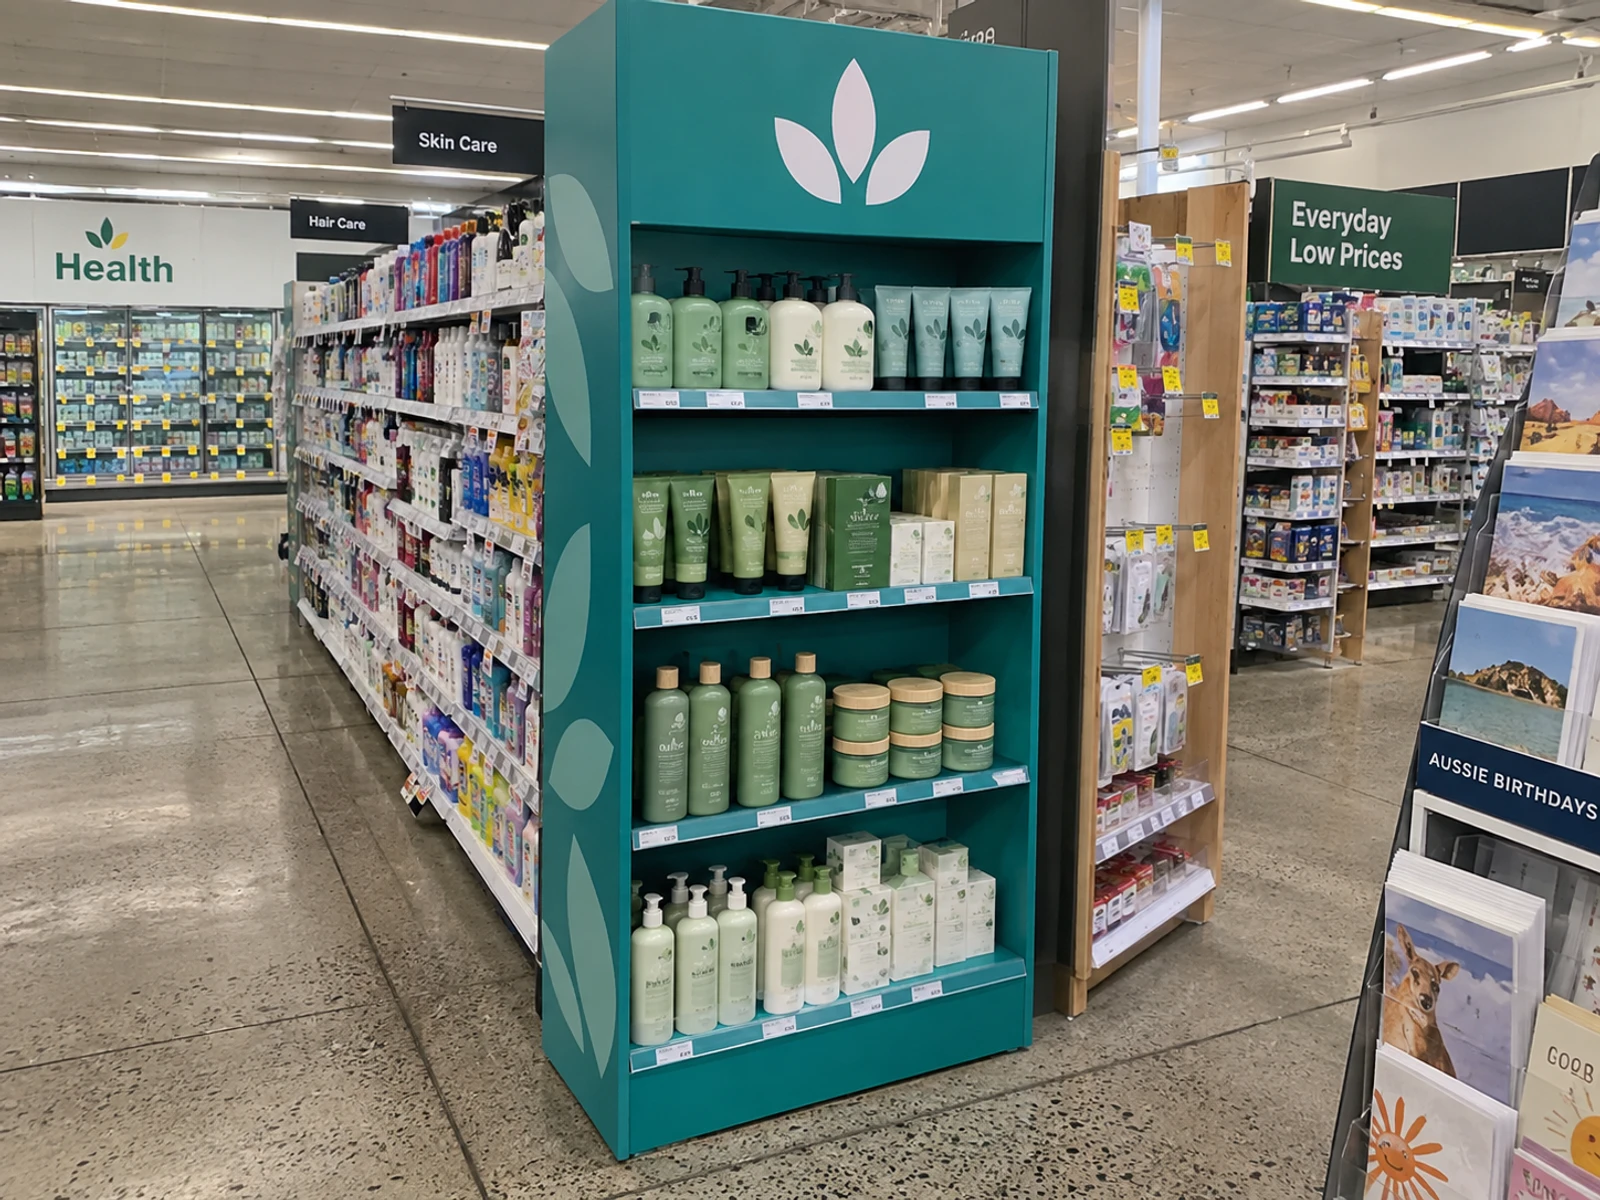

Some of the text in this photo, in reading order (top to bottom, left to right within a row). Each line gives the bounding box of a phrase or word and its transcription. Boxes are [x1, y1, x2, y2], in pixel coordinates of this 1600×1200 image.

[418, 132, 498, 154] Skin Care
[308, 215, 366, 230] Hair Care
[1291, 201, 1391, 241] Everyday
[55, 253, 173, 282] Health
[1290, 238, 1403, 271] Low Prices
[1428, 752, 1598, 821] AUSSIE BIRTHDAYS
